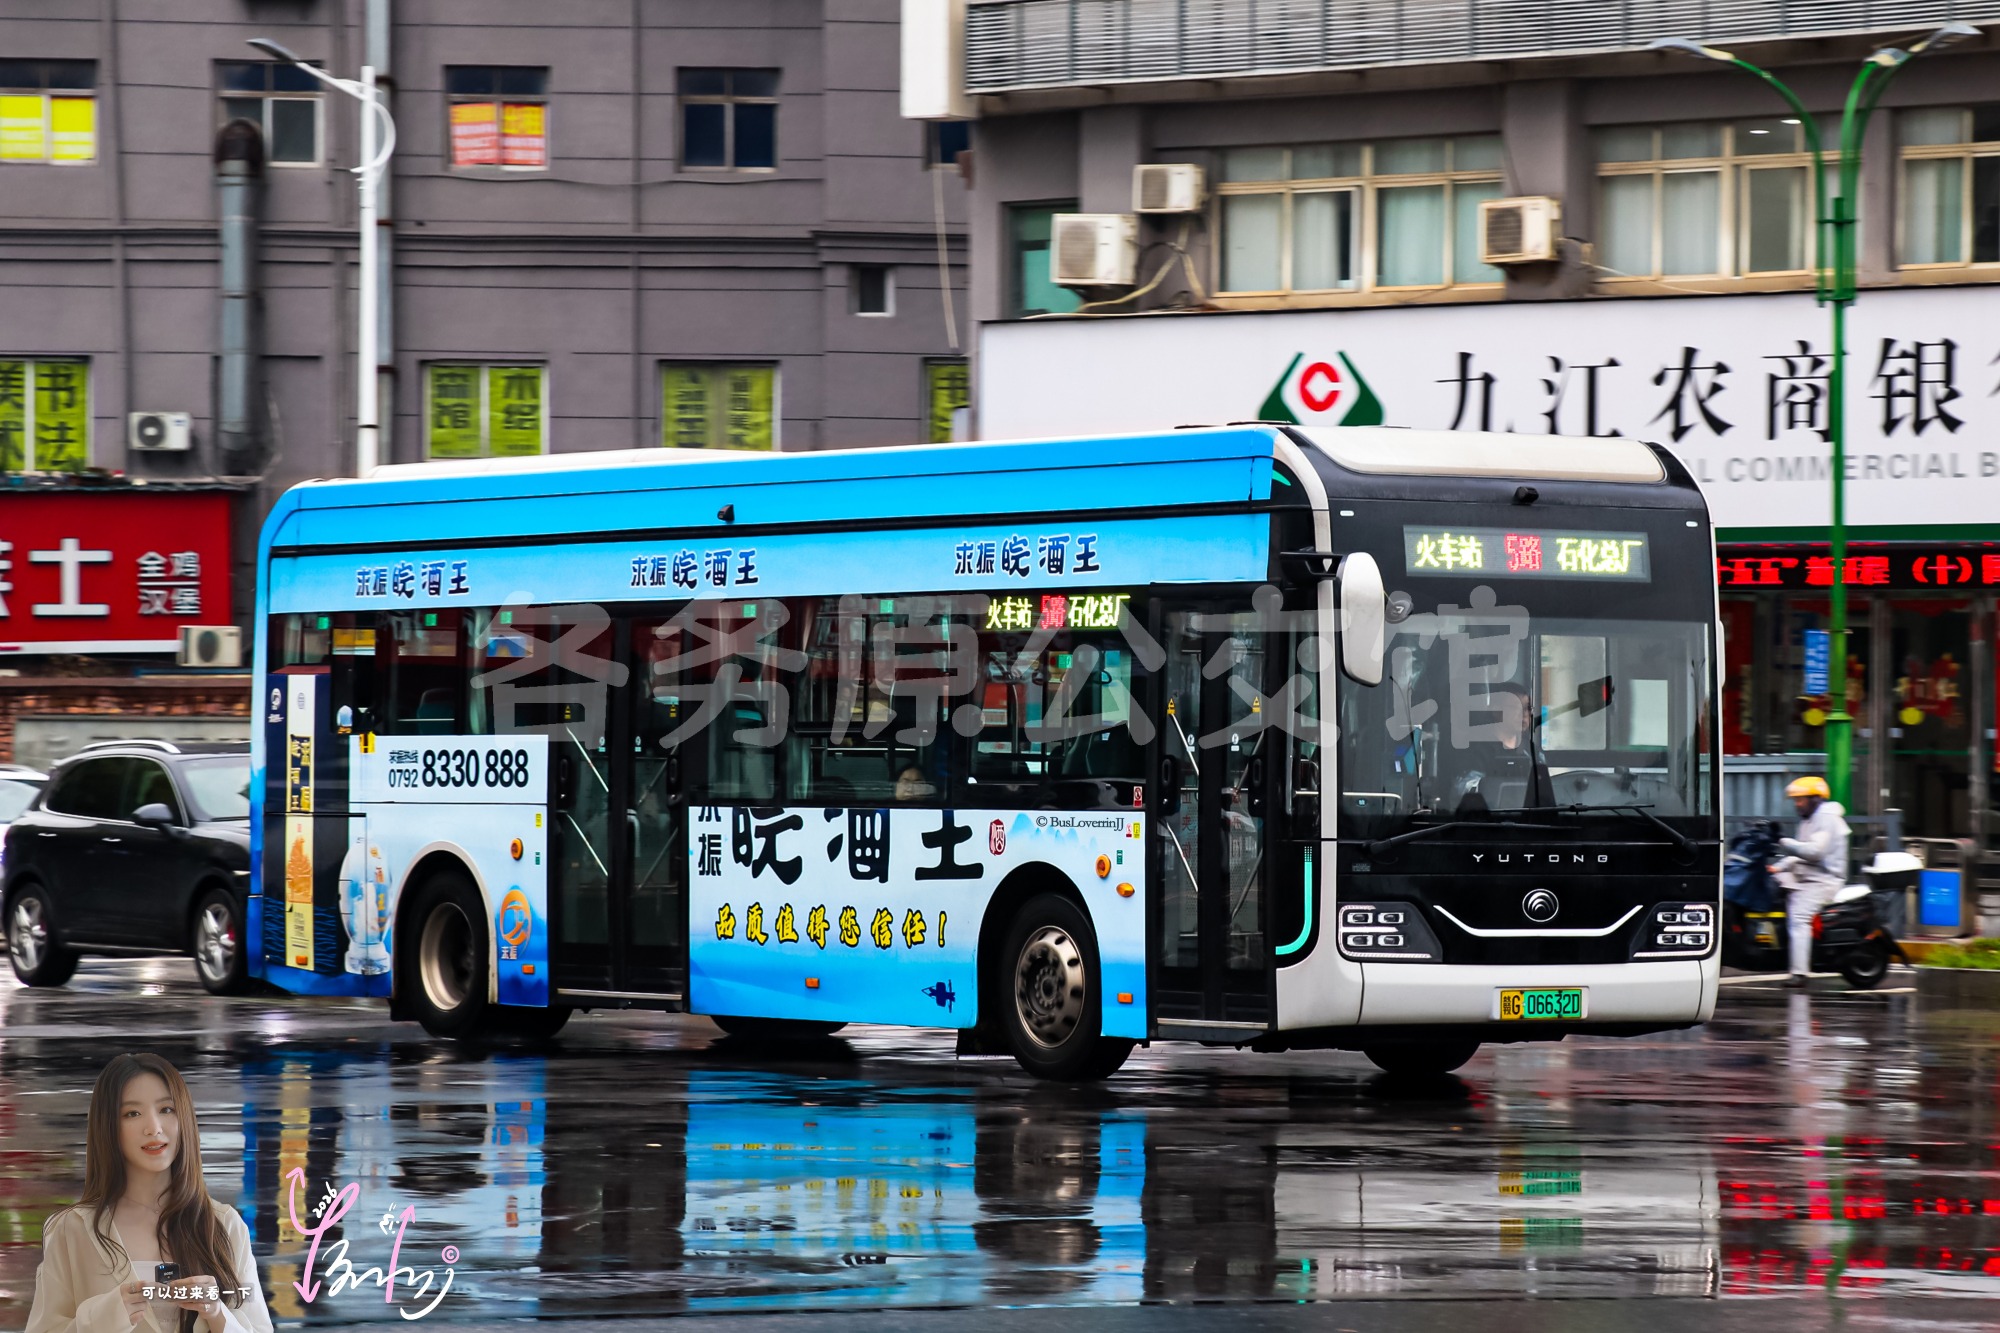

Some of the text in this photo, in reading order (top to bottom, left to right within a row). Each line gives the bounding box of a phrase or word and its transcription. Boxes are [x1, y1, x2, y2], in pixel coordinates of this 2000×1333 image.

[1434, 337, 2000, 443] 九江农商银
[1725, 453, 1968, 483] COMMERCIAL
[630, 548, 760, 591] 求振皖酒王
[954, 533, 1100, 578] 求振皖酒王
[1414, 532, 1644, 574] 火车站 5路 石化总厂
[356, 560, 470, 599] 求振皖酒王
[137, 588, 202, 615] 汉堡
[985, 594, 1132, 631] 火车站 5路 石化总厂
[388, 748, 529, 788] 0792 8330 888
[1472, 853, 1608, 863] YUTONG
